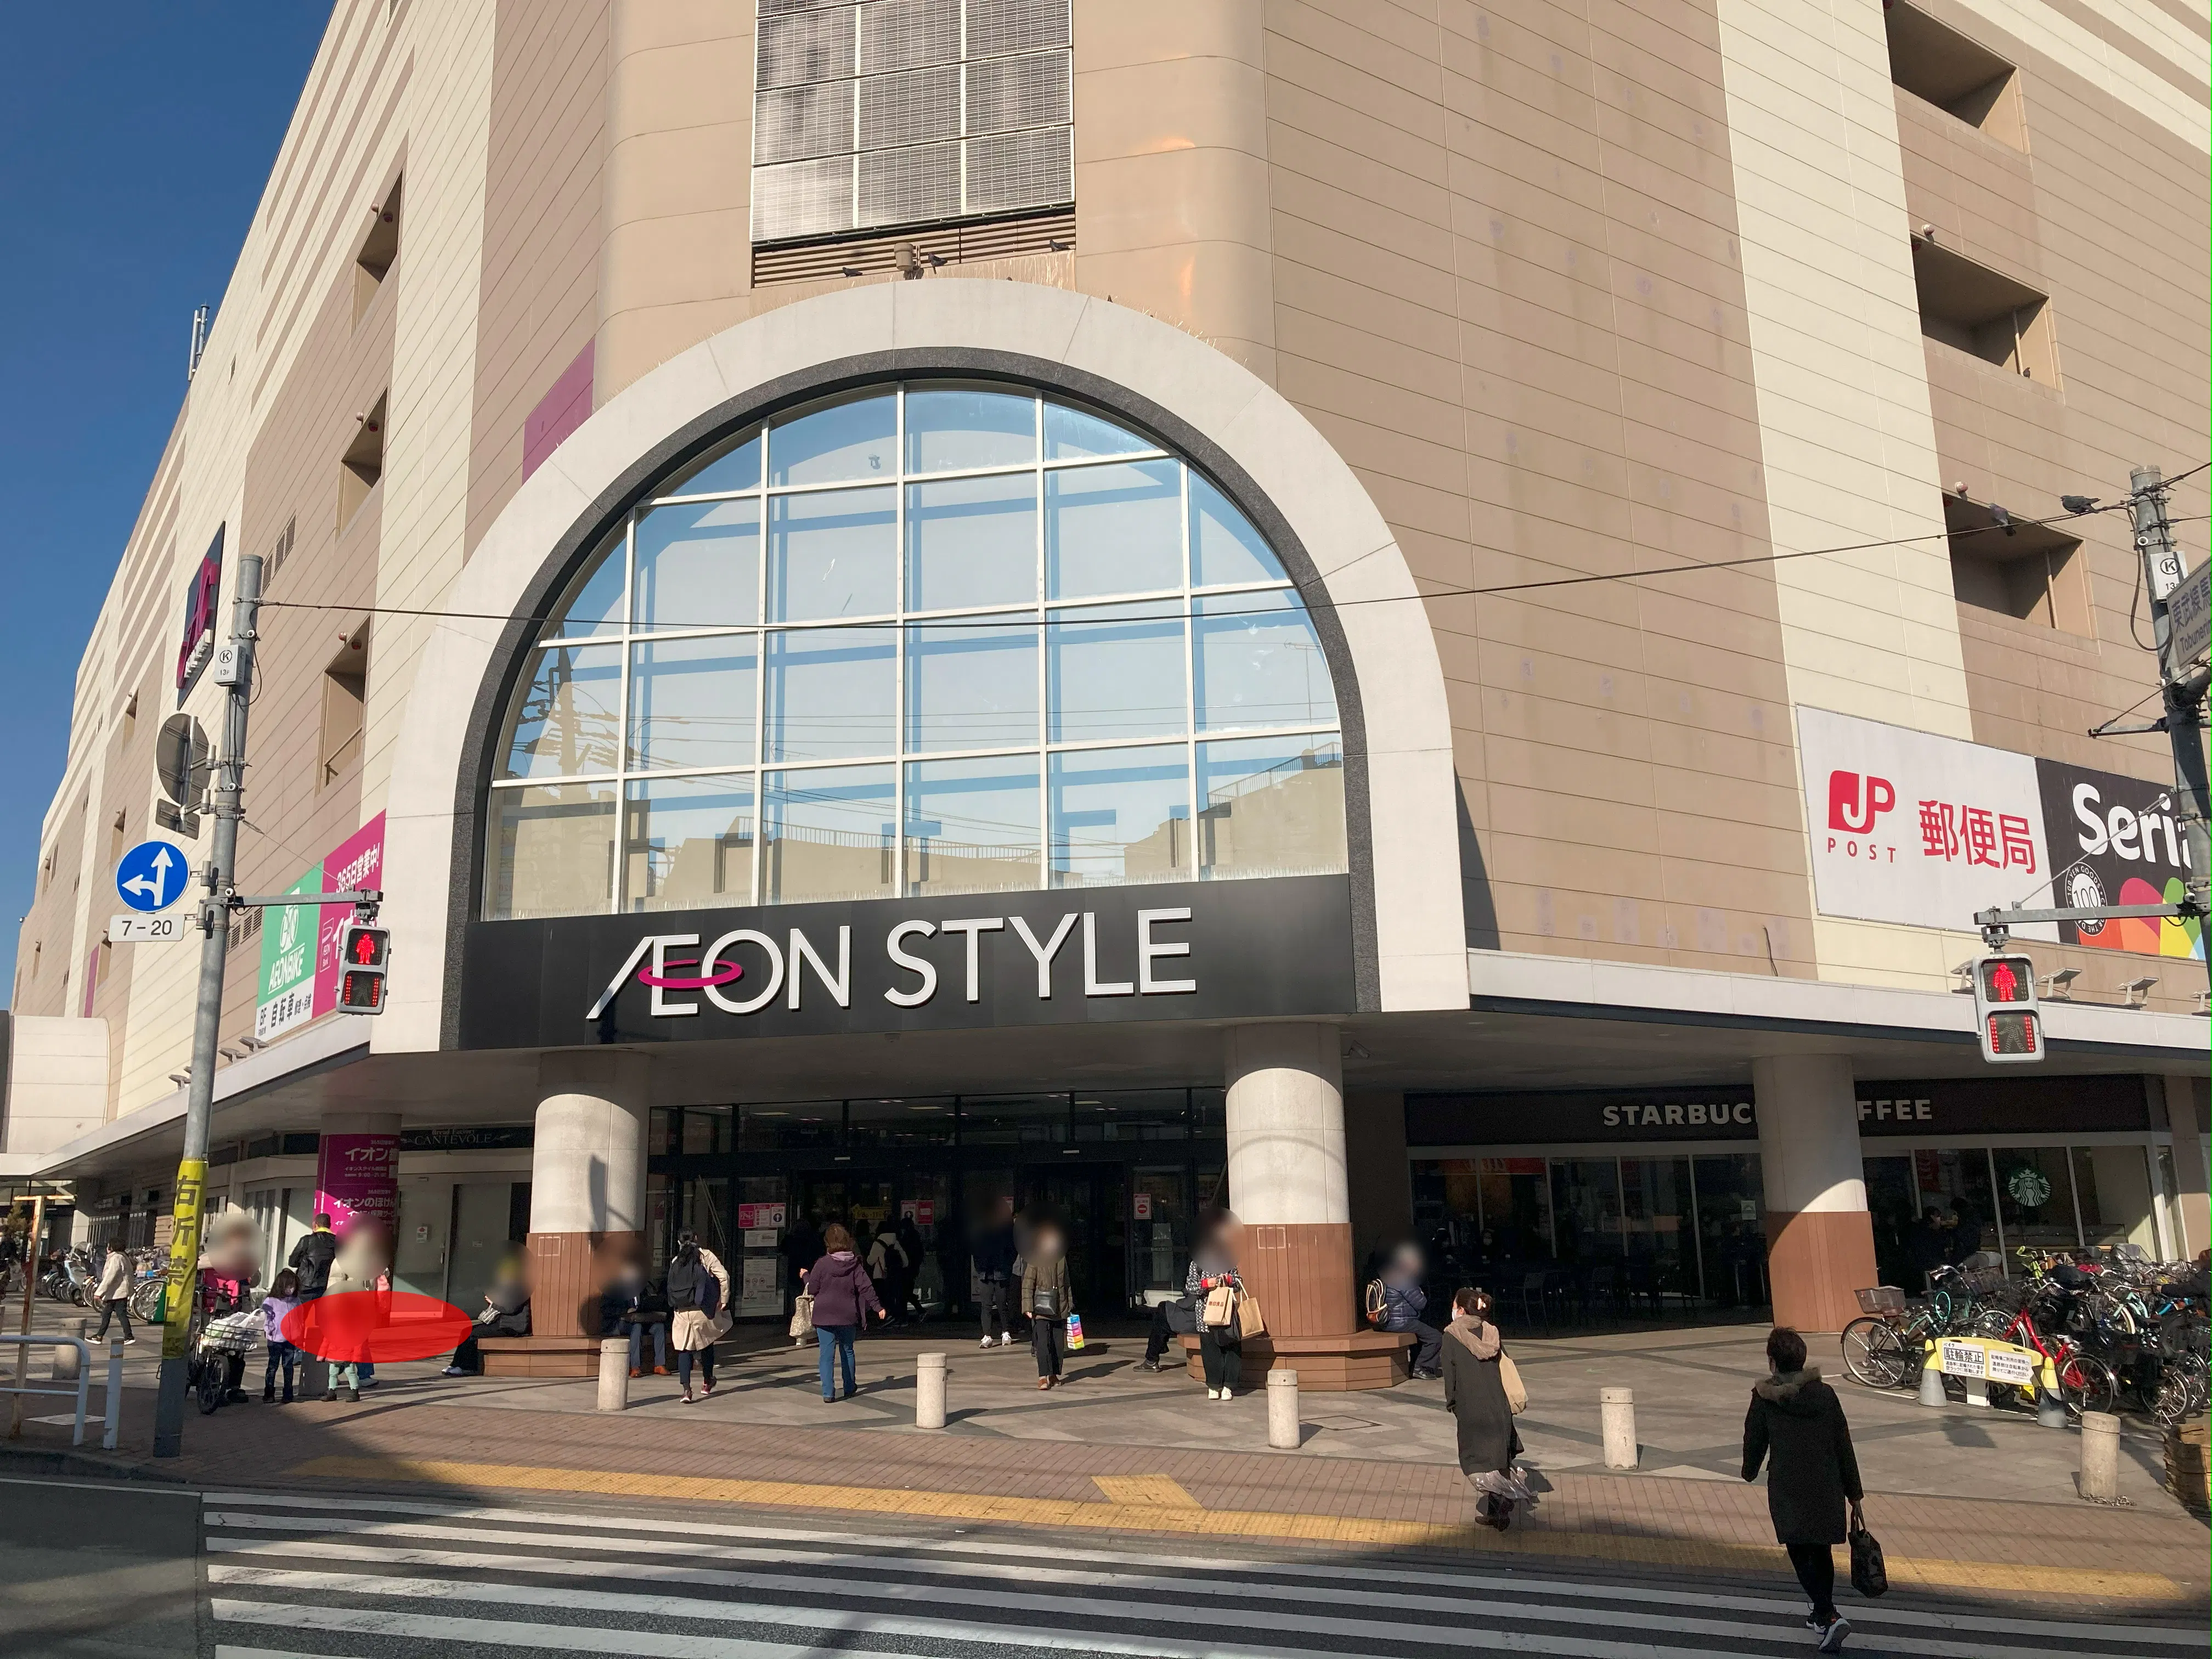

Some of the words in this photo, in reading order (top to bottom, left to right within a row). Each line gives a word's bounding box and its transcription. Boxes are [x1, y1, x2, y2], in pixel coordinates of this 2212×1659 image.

[2171, 572, 2211, 633] 東武練馬
[2180, 617, 2211, 654] Tobuneri
[1827, 837, 1896, 864] POST
[1917, 799, 2036, 874] 郵便局
[2069, 865, 2080, 879] YEN
[2080, 865, 2102, 889] GOODS
[884, 907, 1197, 1007] STYLE
[270, 991, 295, 1028] 自転車
[1602, 1102, 1758, 1127] STARBUC
[1857, 1099, 1933, 1121] FFEE
[1945, 1349, 1983, 1363] 駐輪禁止
